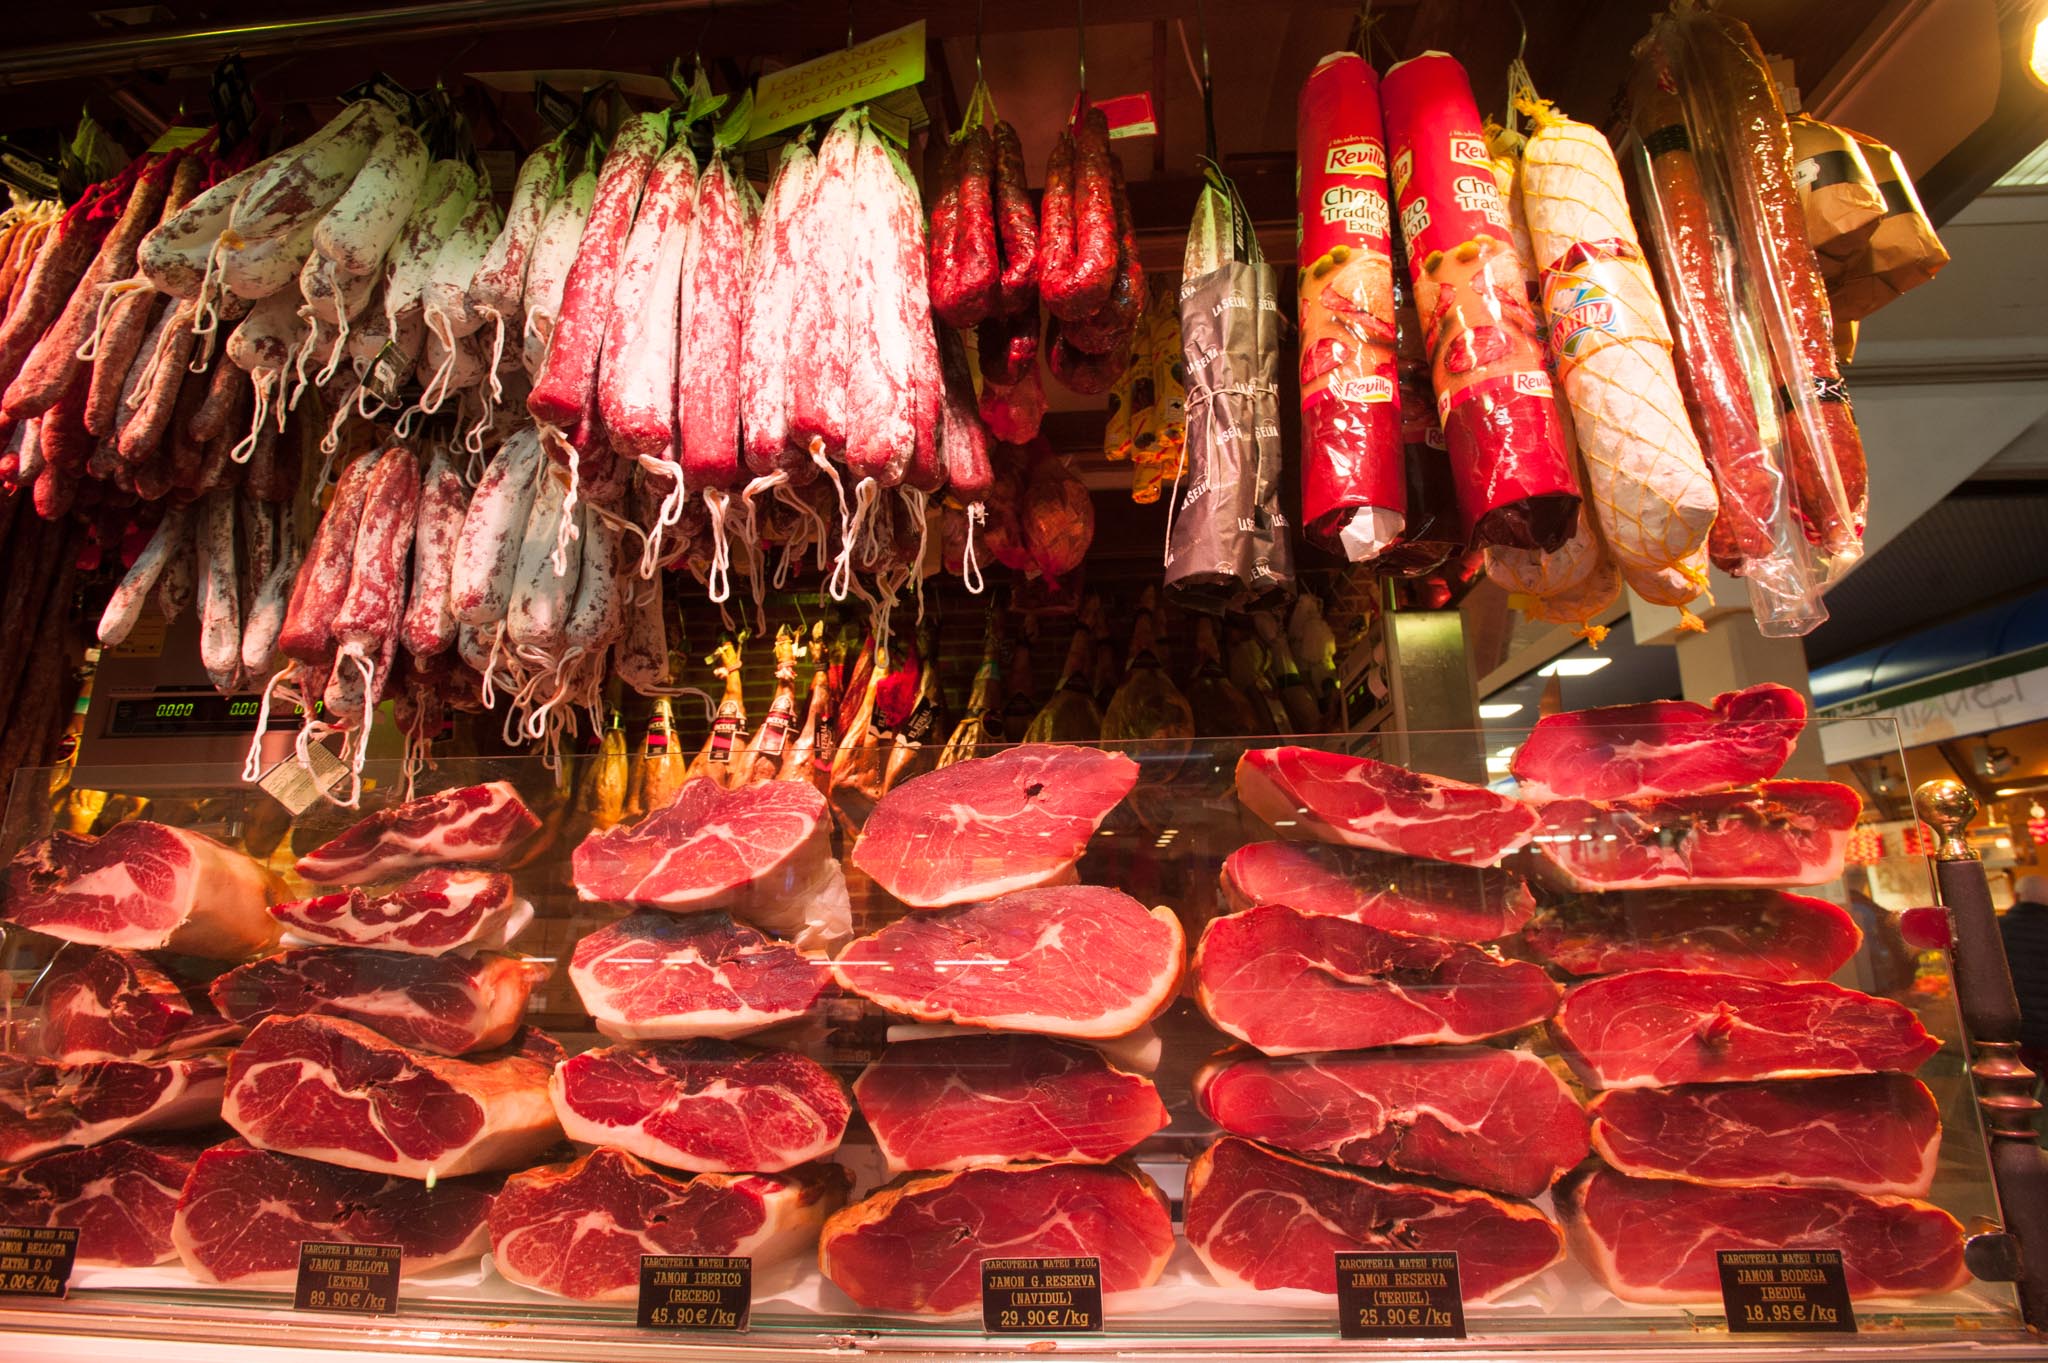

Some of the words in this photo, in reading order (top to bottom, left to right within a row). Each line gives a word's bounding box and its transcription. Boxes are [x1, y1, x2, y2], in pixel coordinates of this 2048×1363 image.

[1345, 378, 1392, 398] Revilla
[0, 1240, 23, 1254] AMON
[26, 1242, 67, 1257] BELLOTA
[354, 1246, 378, 1257] MATEU
[381, 1248, 400, 1258] FIOL
[1, 1256, 30, 1271] EXTRA
[308, 1258, 341, 1271] JAMON
[346, 1260, 389, 1273] BELLOTA
[698, 1257, 724, 1268] MATEU
[728, 1259, 750, 1269] FIOL
[1043, 1259, 1070, 1269] MATEU
[1075, 1258, 1097, 1268] FIOL
[1399, 1258, 1427, 1269] MATEU
[1431, 1258, 1455, 1269] FIOL
[1782, 1253, 1811, 1264] MATEU
[1815, 1253, 1839, 1264] FIOL
[327, 1274, 369, 1289] (EXTRA)
[653, 1271, 688, 1285] JAMON
[694, 1272, 743, 1286] IBERICO
[989, 1275, 1025, 1288] JAMON
[1031, 1274, 1096, 1287] G.RESERVA
[1351, 1272, 1388, 1286] JAMON
[1394, 1272, 1448, 1286] RESERVA
[1738, 1269, 1775, 1282] JAMON
[1780, 1269, 1827, 1282] BODEGA
[668, 1288, 721, 1303] (RECEBO)
[1011, 1290, 1073, 1306] (NAVIDUL)
[1373, 1290, 1430, 1306] (TERUEL)
[1760, 1286, 1807, 1300] IBEDUL
